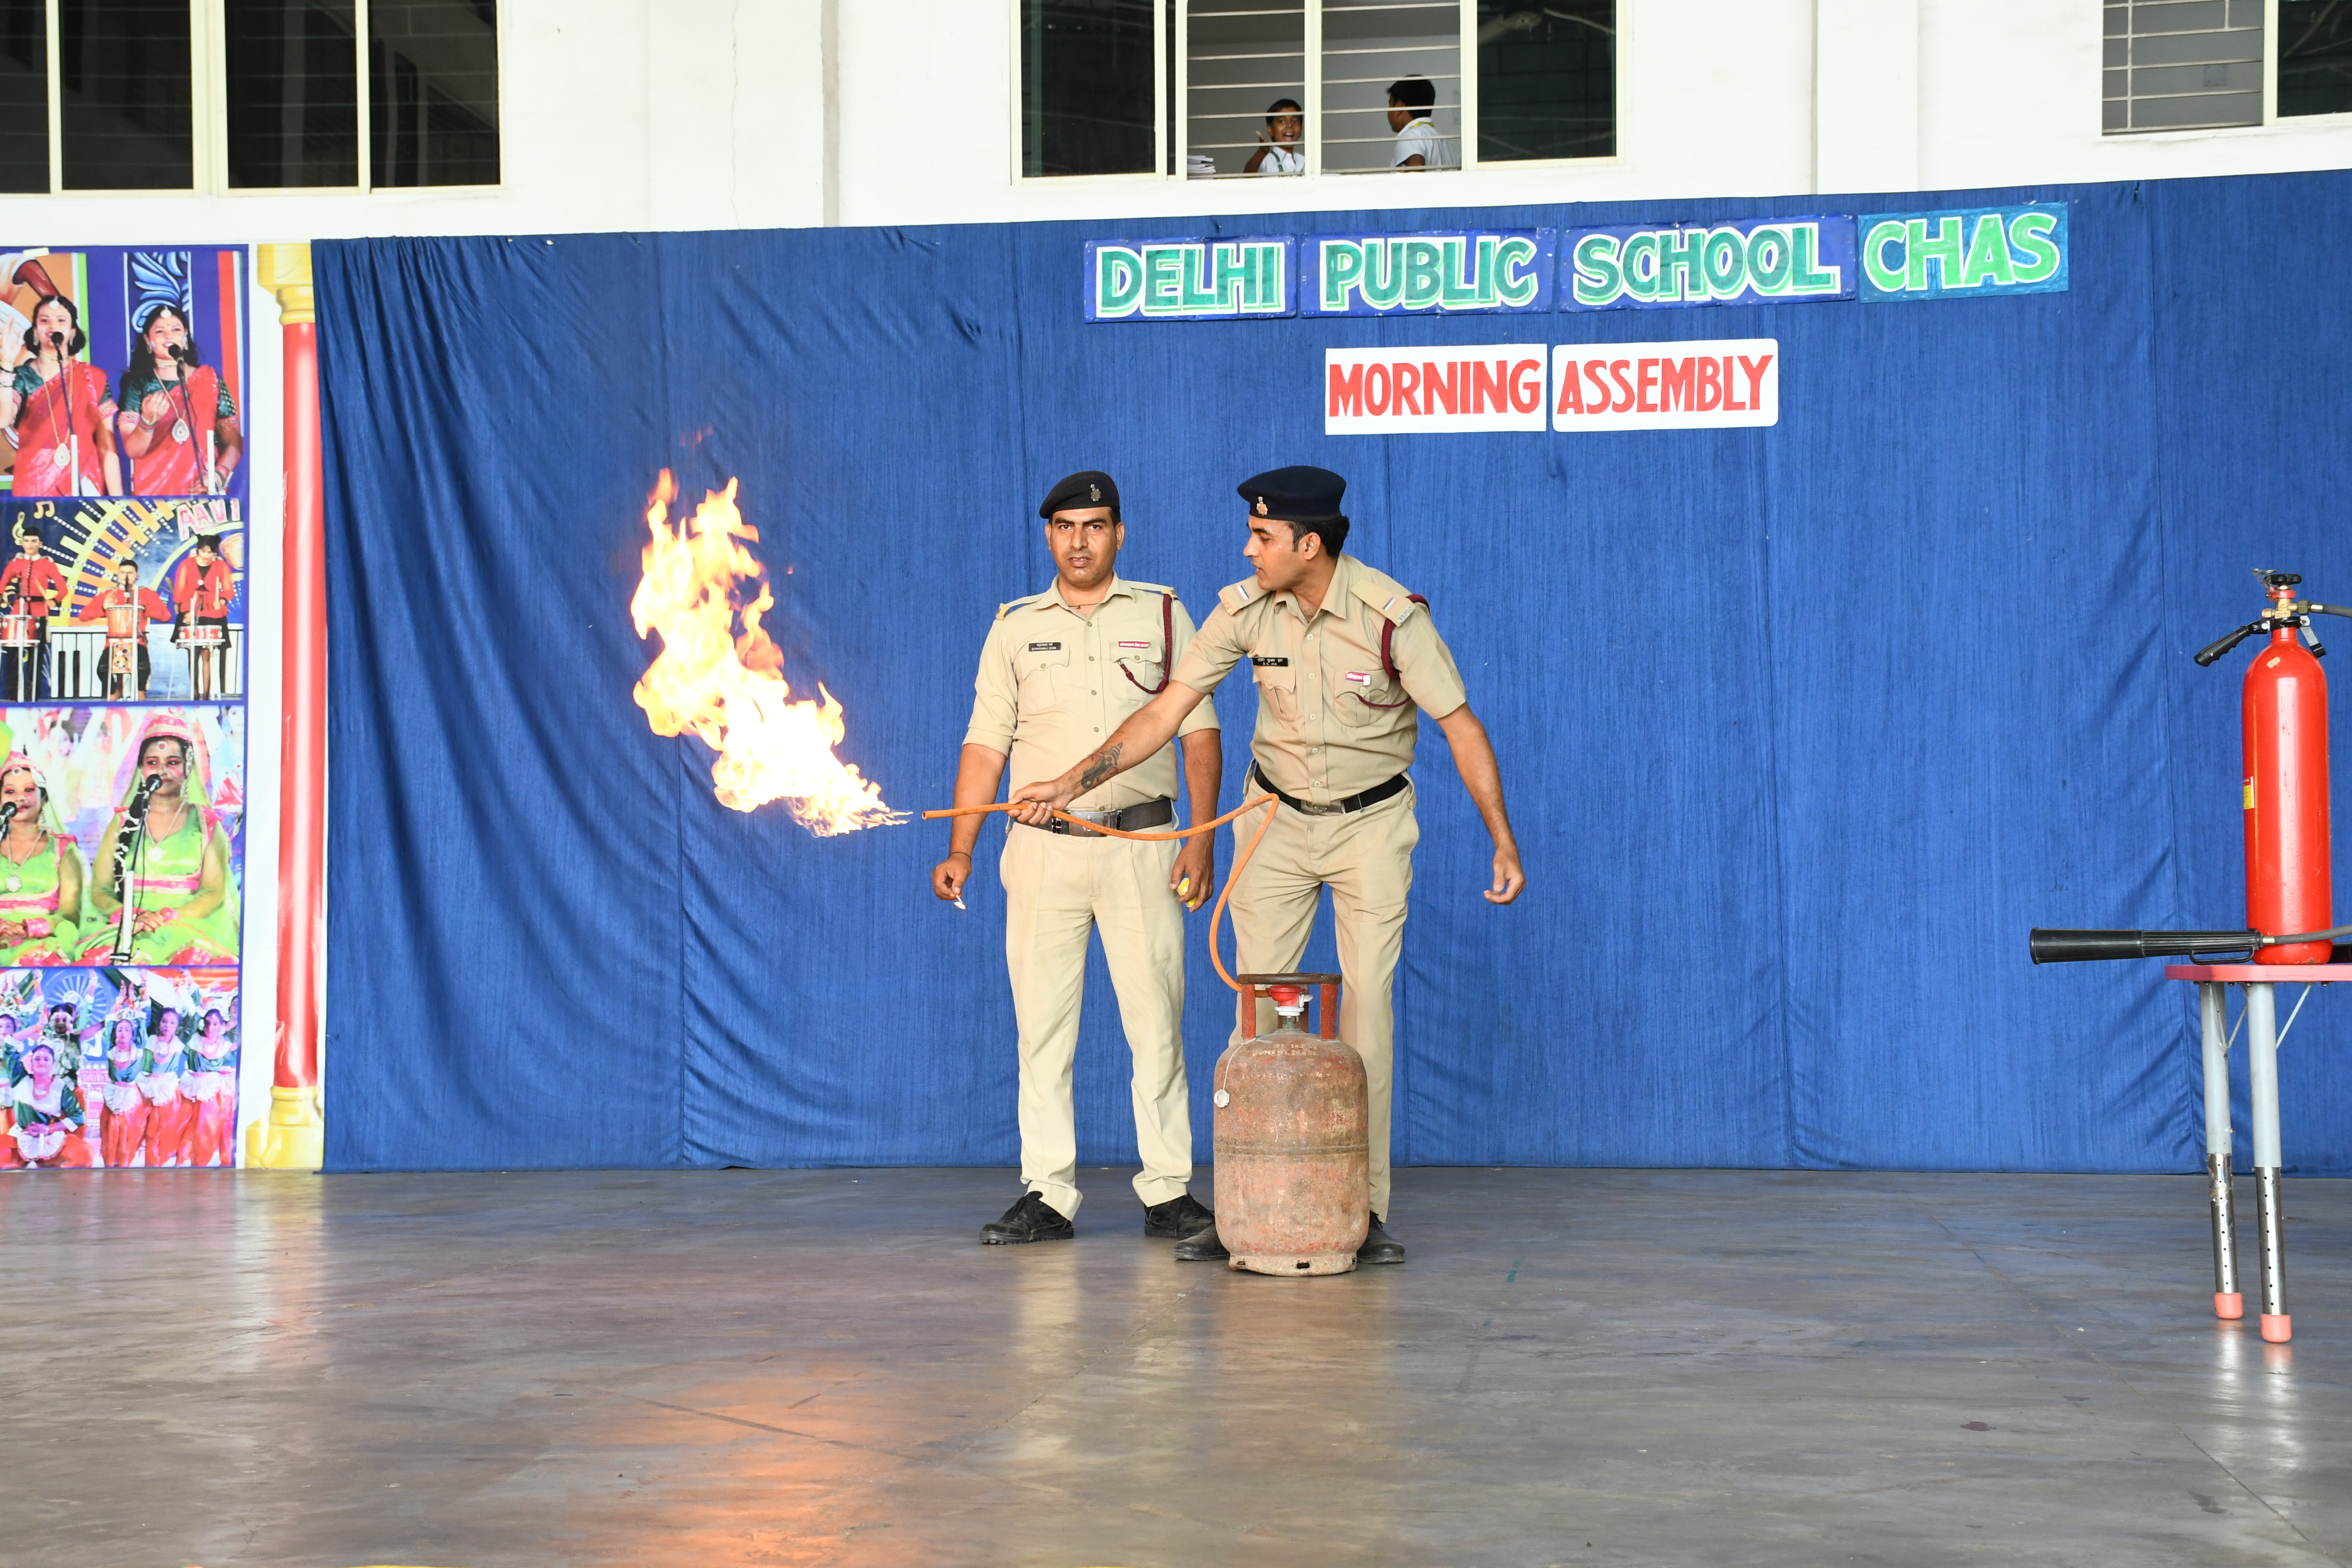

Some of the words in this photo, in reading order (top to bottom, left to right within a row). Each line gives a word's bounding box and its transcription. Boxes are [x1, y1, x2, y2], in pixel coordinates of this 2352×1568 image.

[1097, 242, 1285, 318] DELHI
[1320, 236, 1539, 311] PUBLIC
[1573, 223, 1841, 305] SCHOOL
[1863, 212, 2060, 292] CHAS
[1329, 359, 1541, 417] MORNING
[1557, 355, 1775, 415] ASSEMBLY
